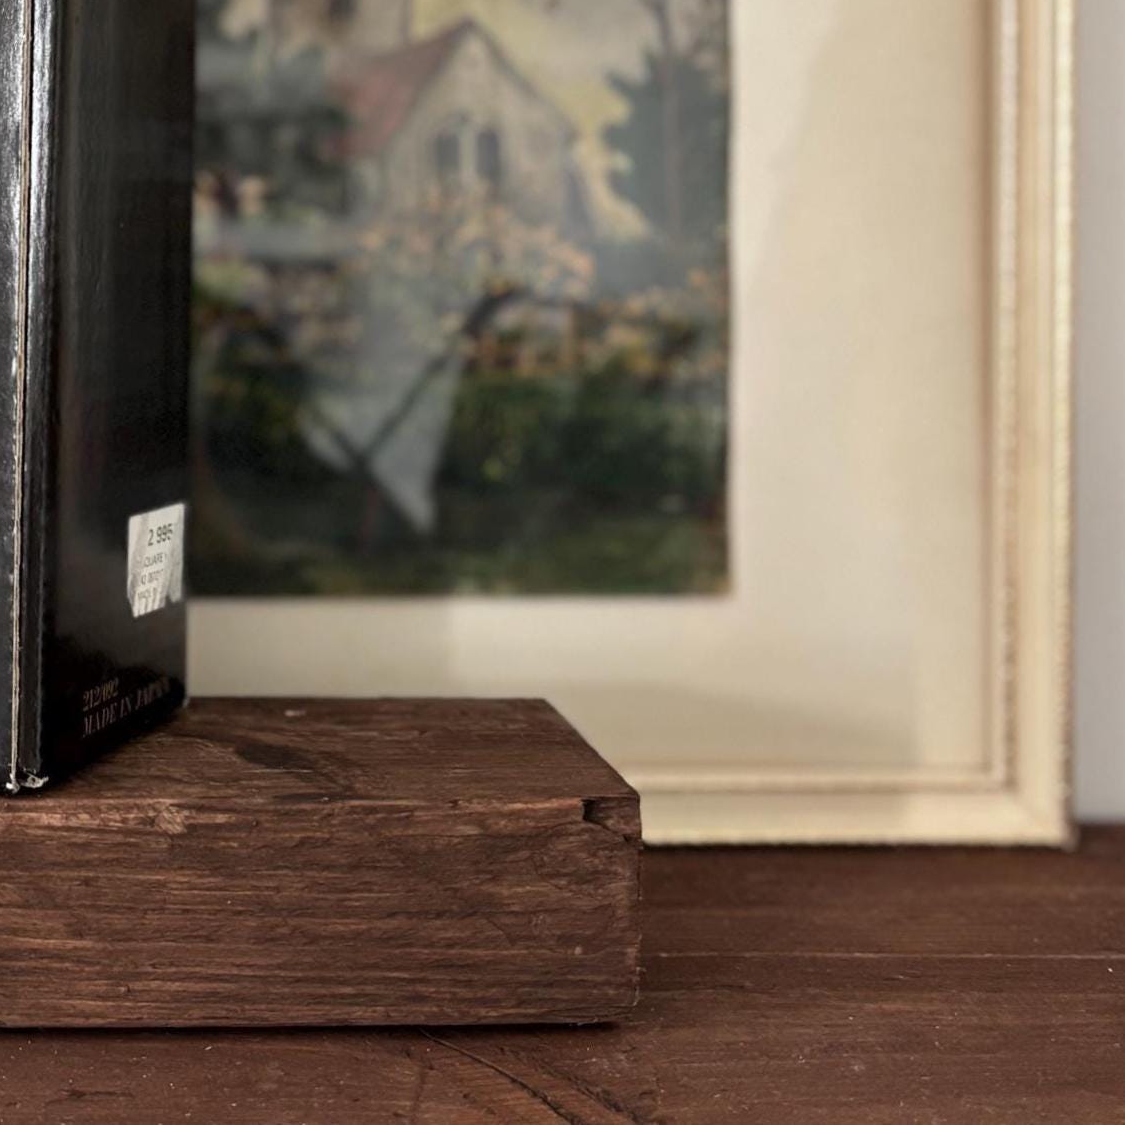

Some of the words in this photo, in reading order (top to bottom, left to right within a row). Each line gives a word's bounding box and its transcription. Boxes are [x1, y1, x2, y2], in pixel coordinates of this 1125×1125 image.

[147, 528, 154, 547] 2
[82, 703, 118, 738] MADE
[120, 696, 132, 718] IN
